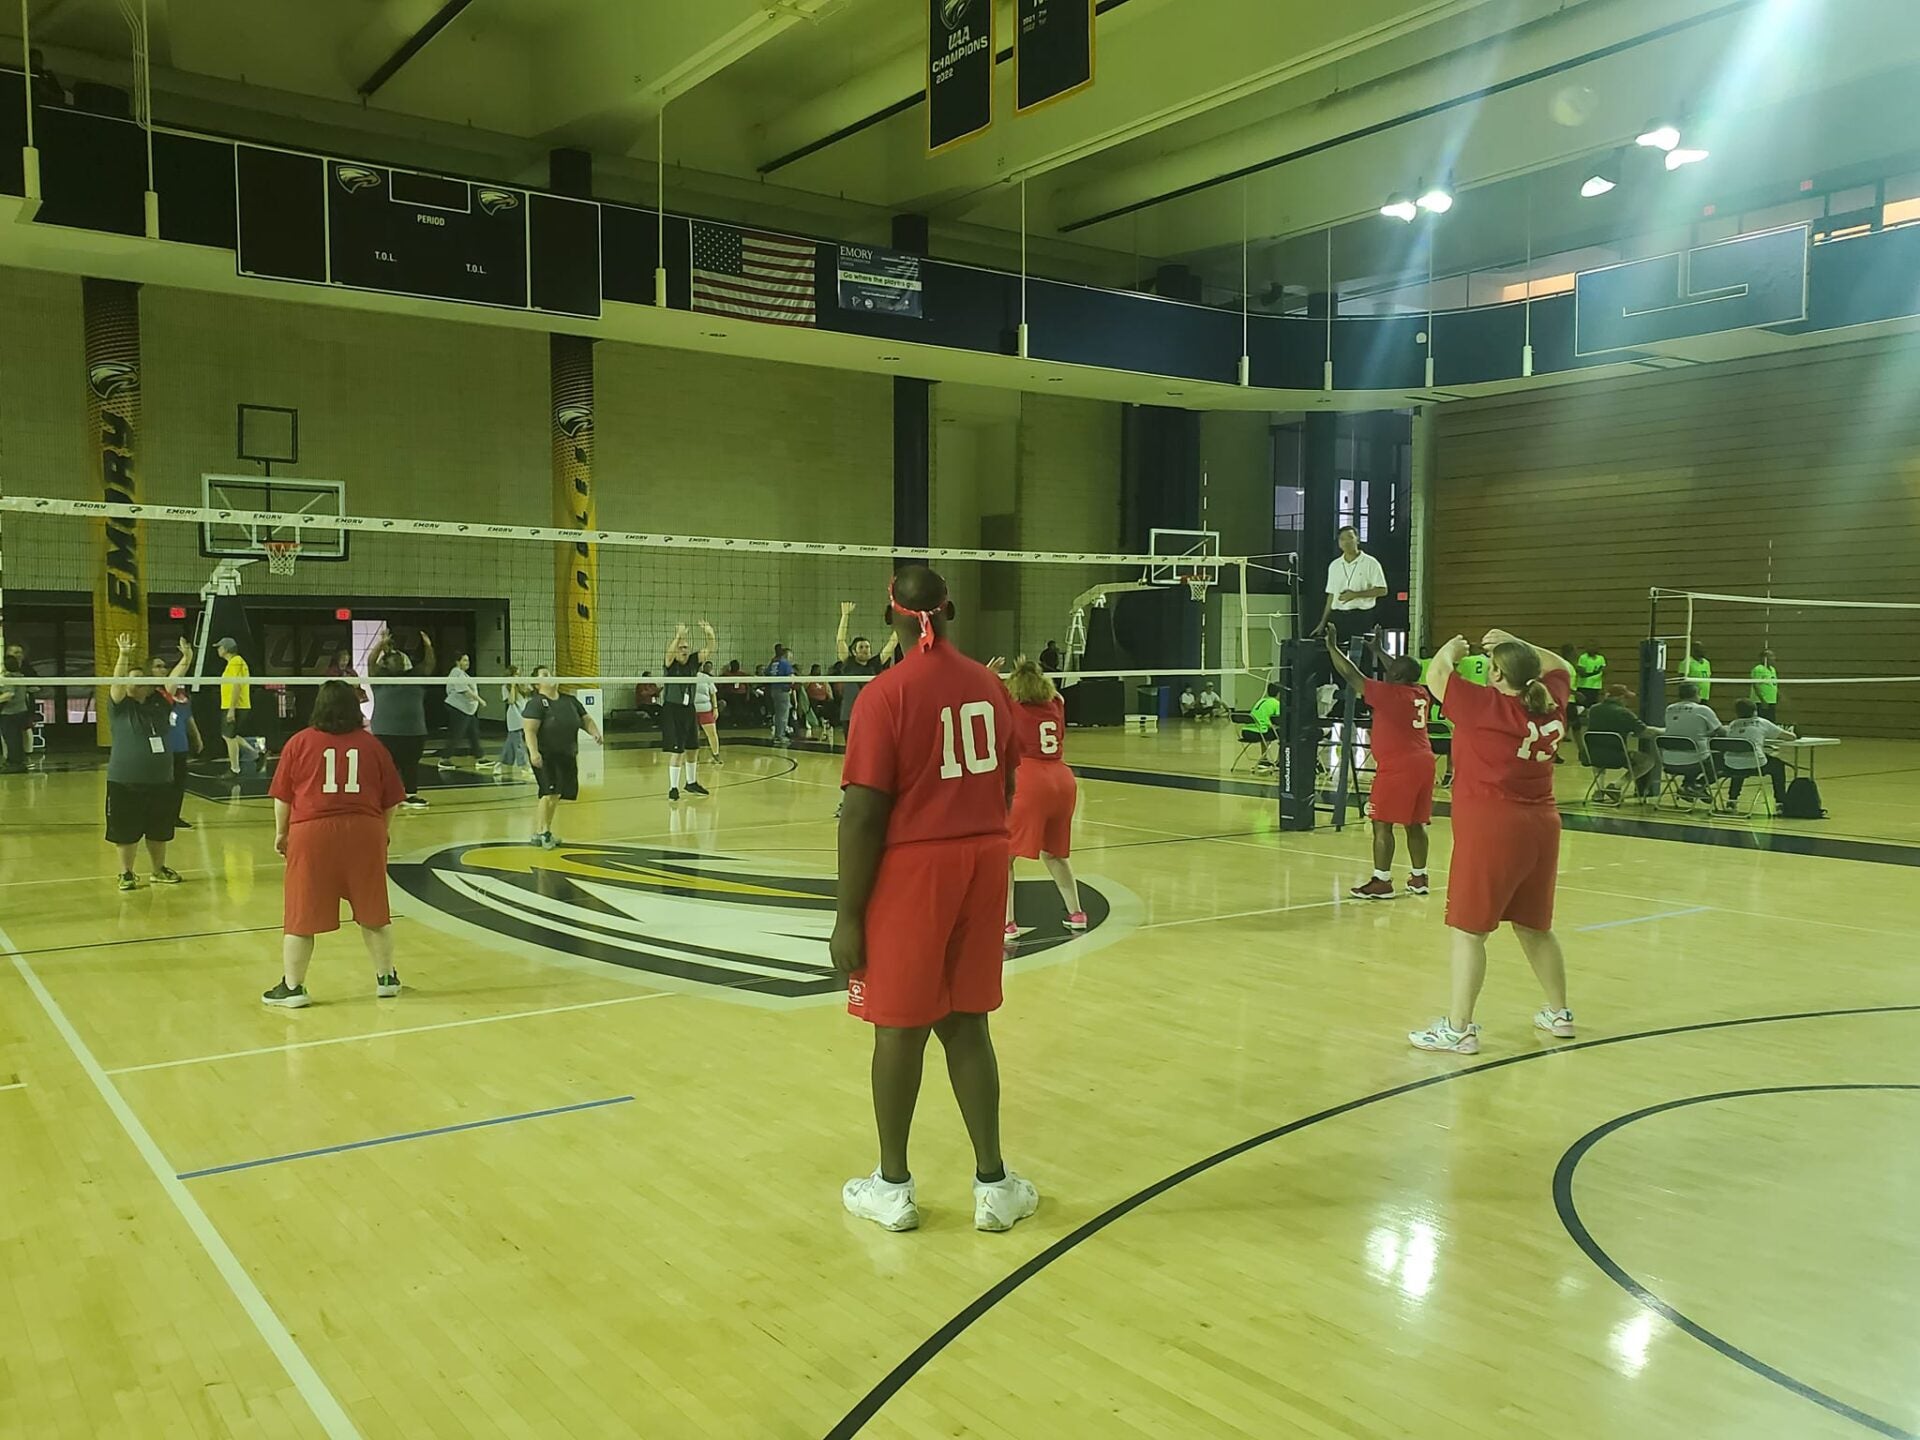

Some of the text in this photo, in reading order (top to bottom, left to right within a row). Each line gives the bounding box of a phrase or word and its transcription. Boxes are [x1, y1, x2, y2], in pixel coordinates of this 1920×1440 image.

[948, 25, 970, 50] UAA
[932, 36, 988, 73] CHAMPIONS
[936, 67, 954, 84] 2022
[417, 214, 445, 226] PERIOD
[374, 250, 397, 262] T.O.L.
[840, 245, 873, 260] EMORY
[465, 263, 487, 274] T.O.L.
[1475, 660, 1483, 674] 2
[1412, 699, 1427, 729] 3
[940, 700, 998, 780] 10
[1039, 721, 1059, 754] 6
[322, 748, 360, 793] 11
